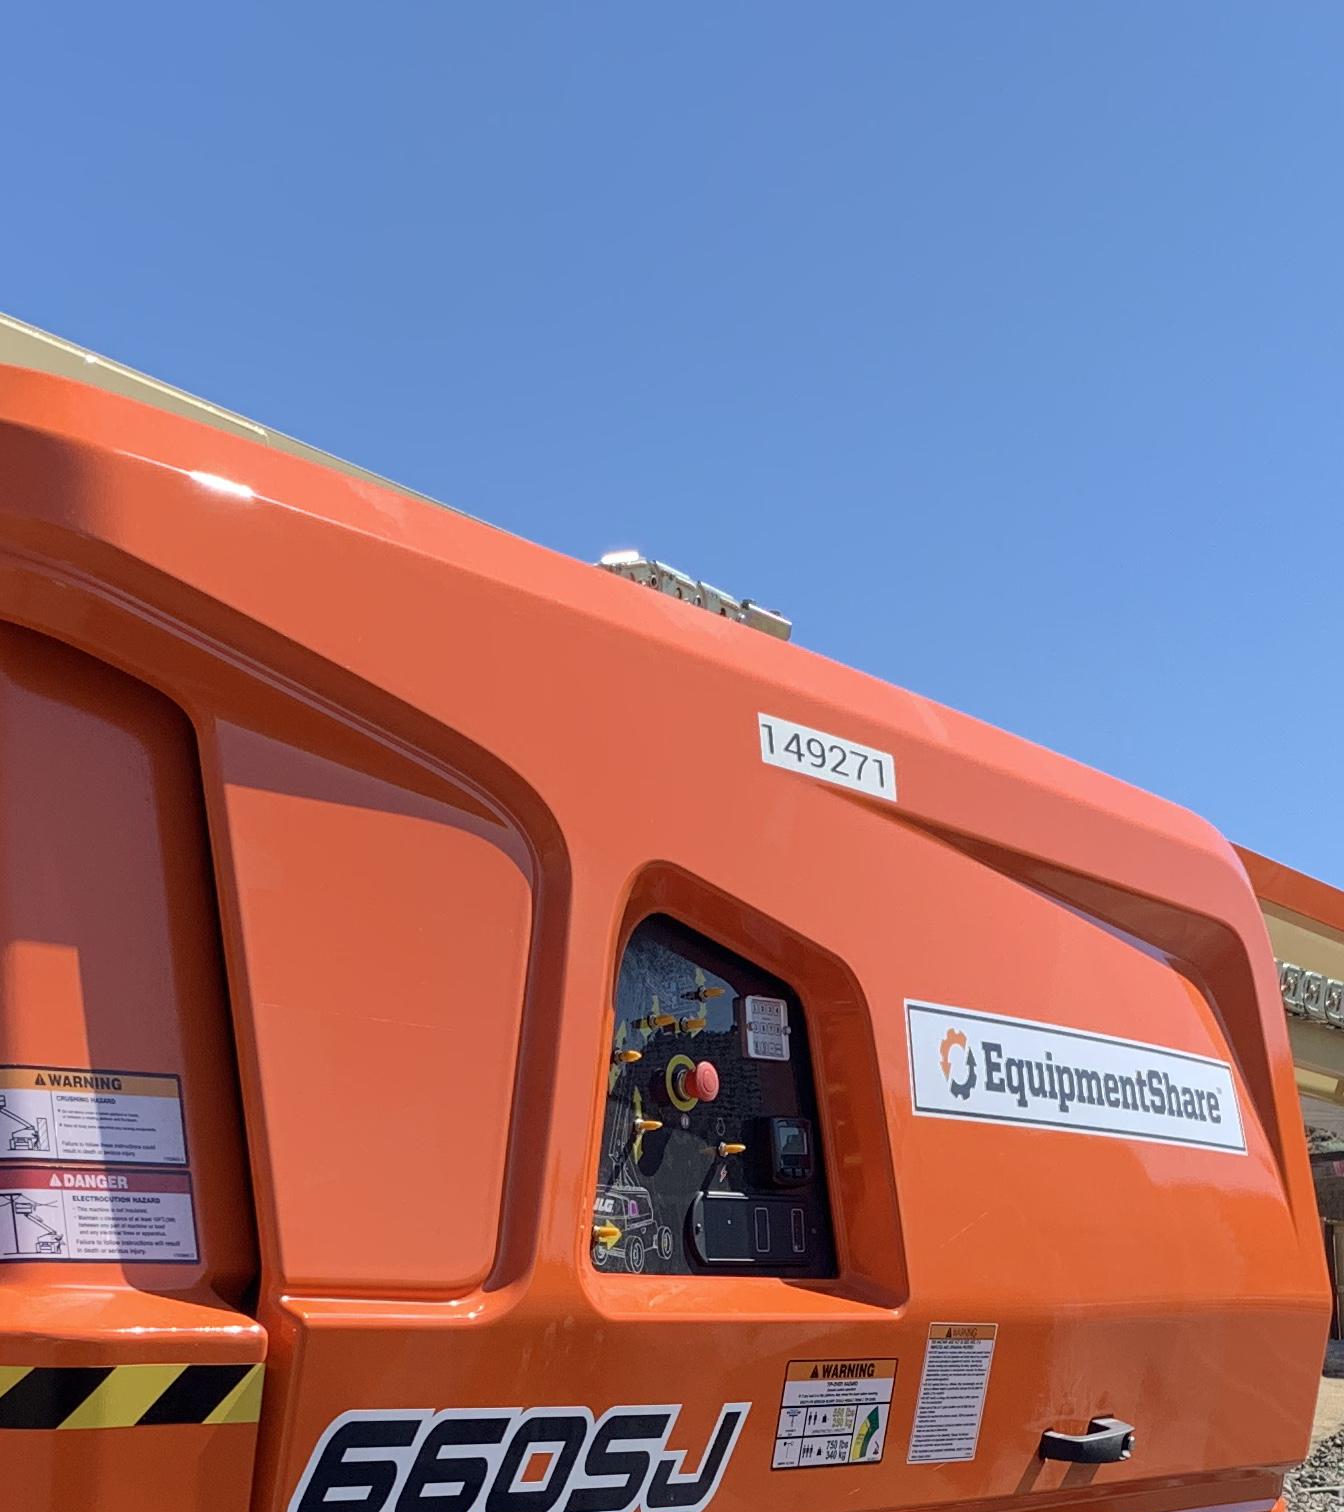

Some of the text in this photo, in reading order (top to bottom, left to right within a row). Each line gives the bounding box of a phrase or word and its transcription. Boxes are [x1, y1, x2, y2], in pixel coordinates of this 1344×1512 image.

[763, 721, 887, 789] 149271
[49, 1074, 122, 1090] WARNING
[983, 1041, 1221, 1125] EquipmentShare
[64, 1174, 128, 1190] DANGER
[822, 1363, 875, 1378] WARNING
